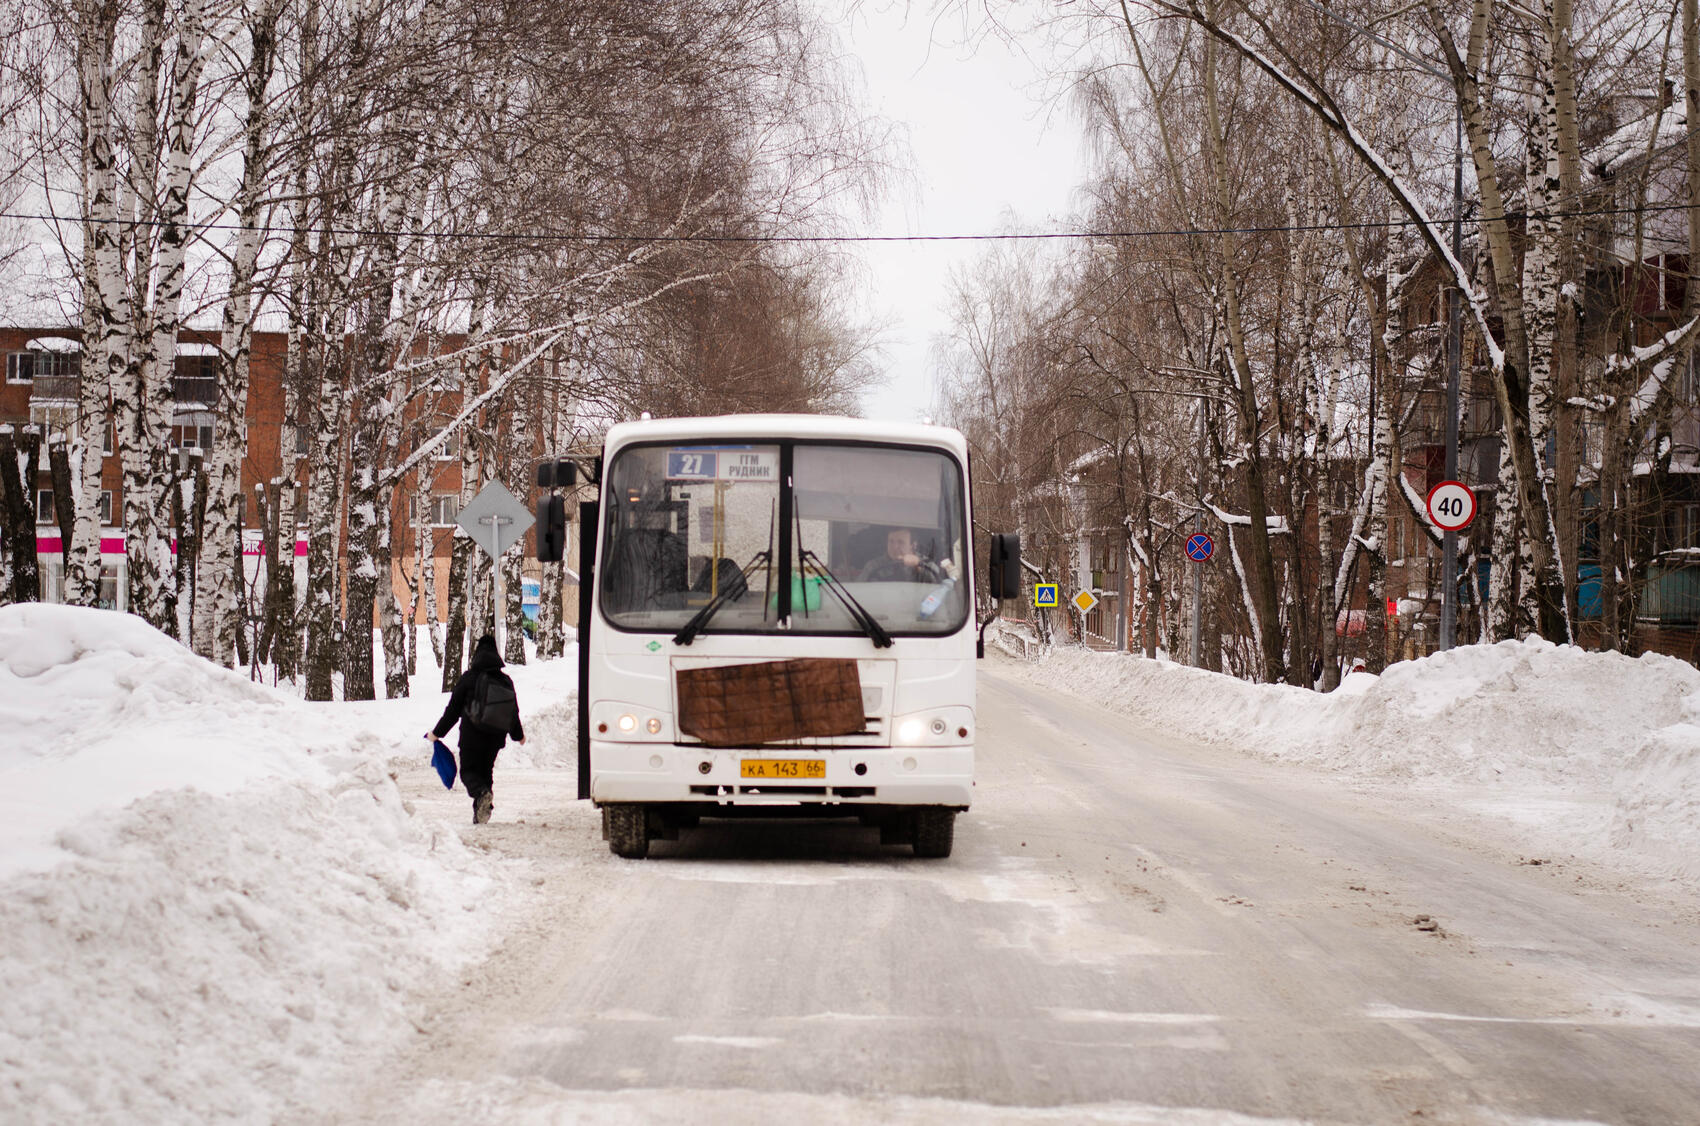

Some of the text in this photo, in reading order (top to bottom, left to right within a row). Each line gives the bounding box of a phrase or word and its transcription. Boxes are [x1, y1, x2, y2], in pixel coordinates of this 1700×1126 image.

[681, 454, 703, 474] 27
[729, 466, 770, 477] РУДНИК
[1438, 497, 1463, 517] 40
[773, 763, 798, 776] 143
[806, 762, 820, 772] 66
